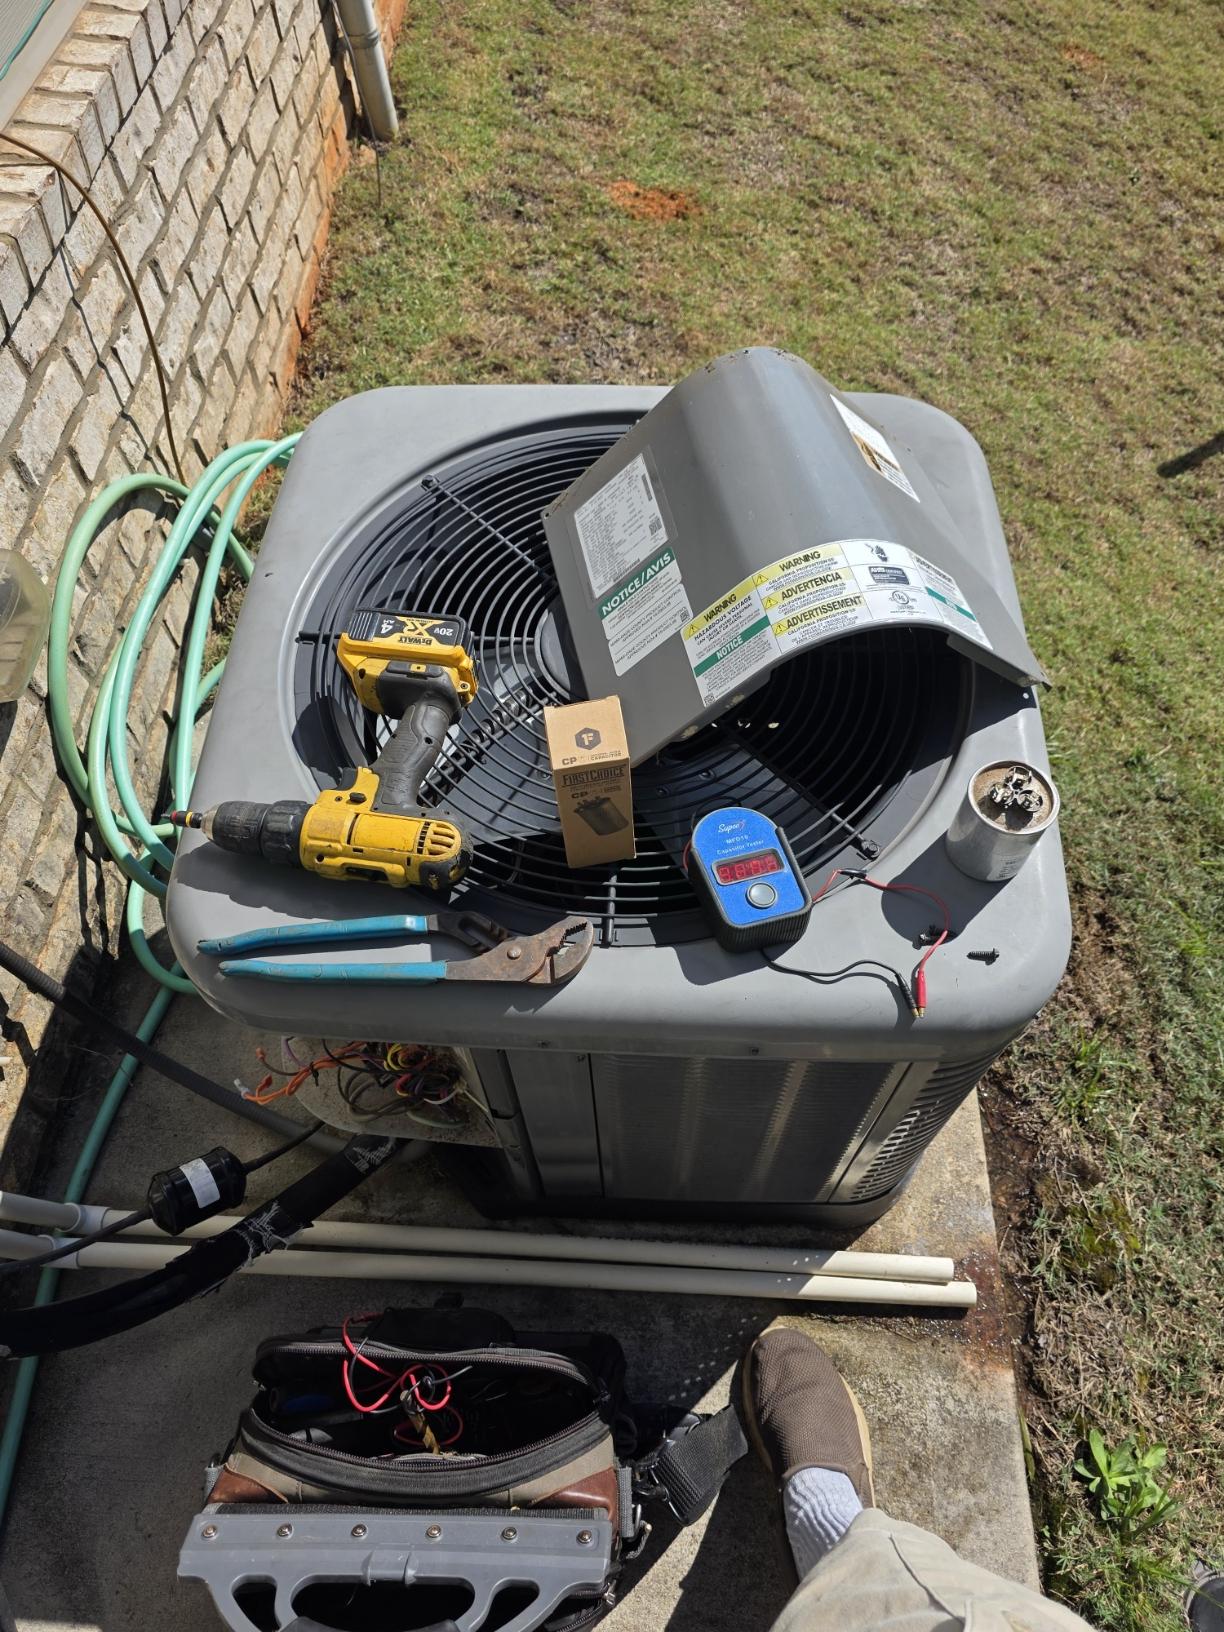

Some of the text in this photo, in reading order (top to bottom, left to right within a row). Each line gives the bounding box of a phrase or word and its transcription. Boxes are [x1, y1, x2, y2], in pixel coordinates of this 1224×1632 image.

[780, 551, 820, 571] WARNING
[602, 552, 671, 616] NOTICE/AVIS
[781, 572, 841, 600] ADVERTENCIA
[694, 614, 726, 641] HAZARDOUS
[728, 595, 751, 615] VOLTAGE
[703, 594, 736, 622] WARNING
[786, 594, 862, 628] ADVERTISSEMENT
[380, 624, 393, 634] 4
[716, 635, 743, 659] NOTICE
[562, 756, 577, 766] CP
